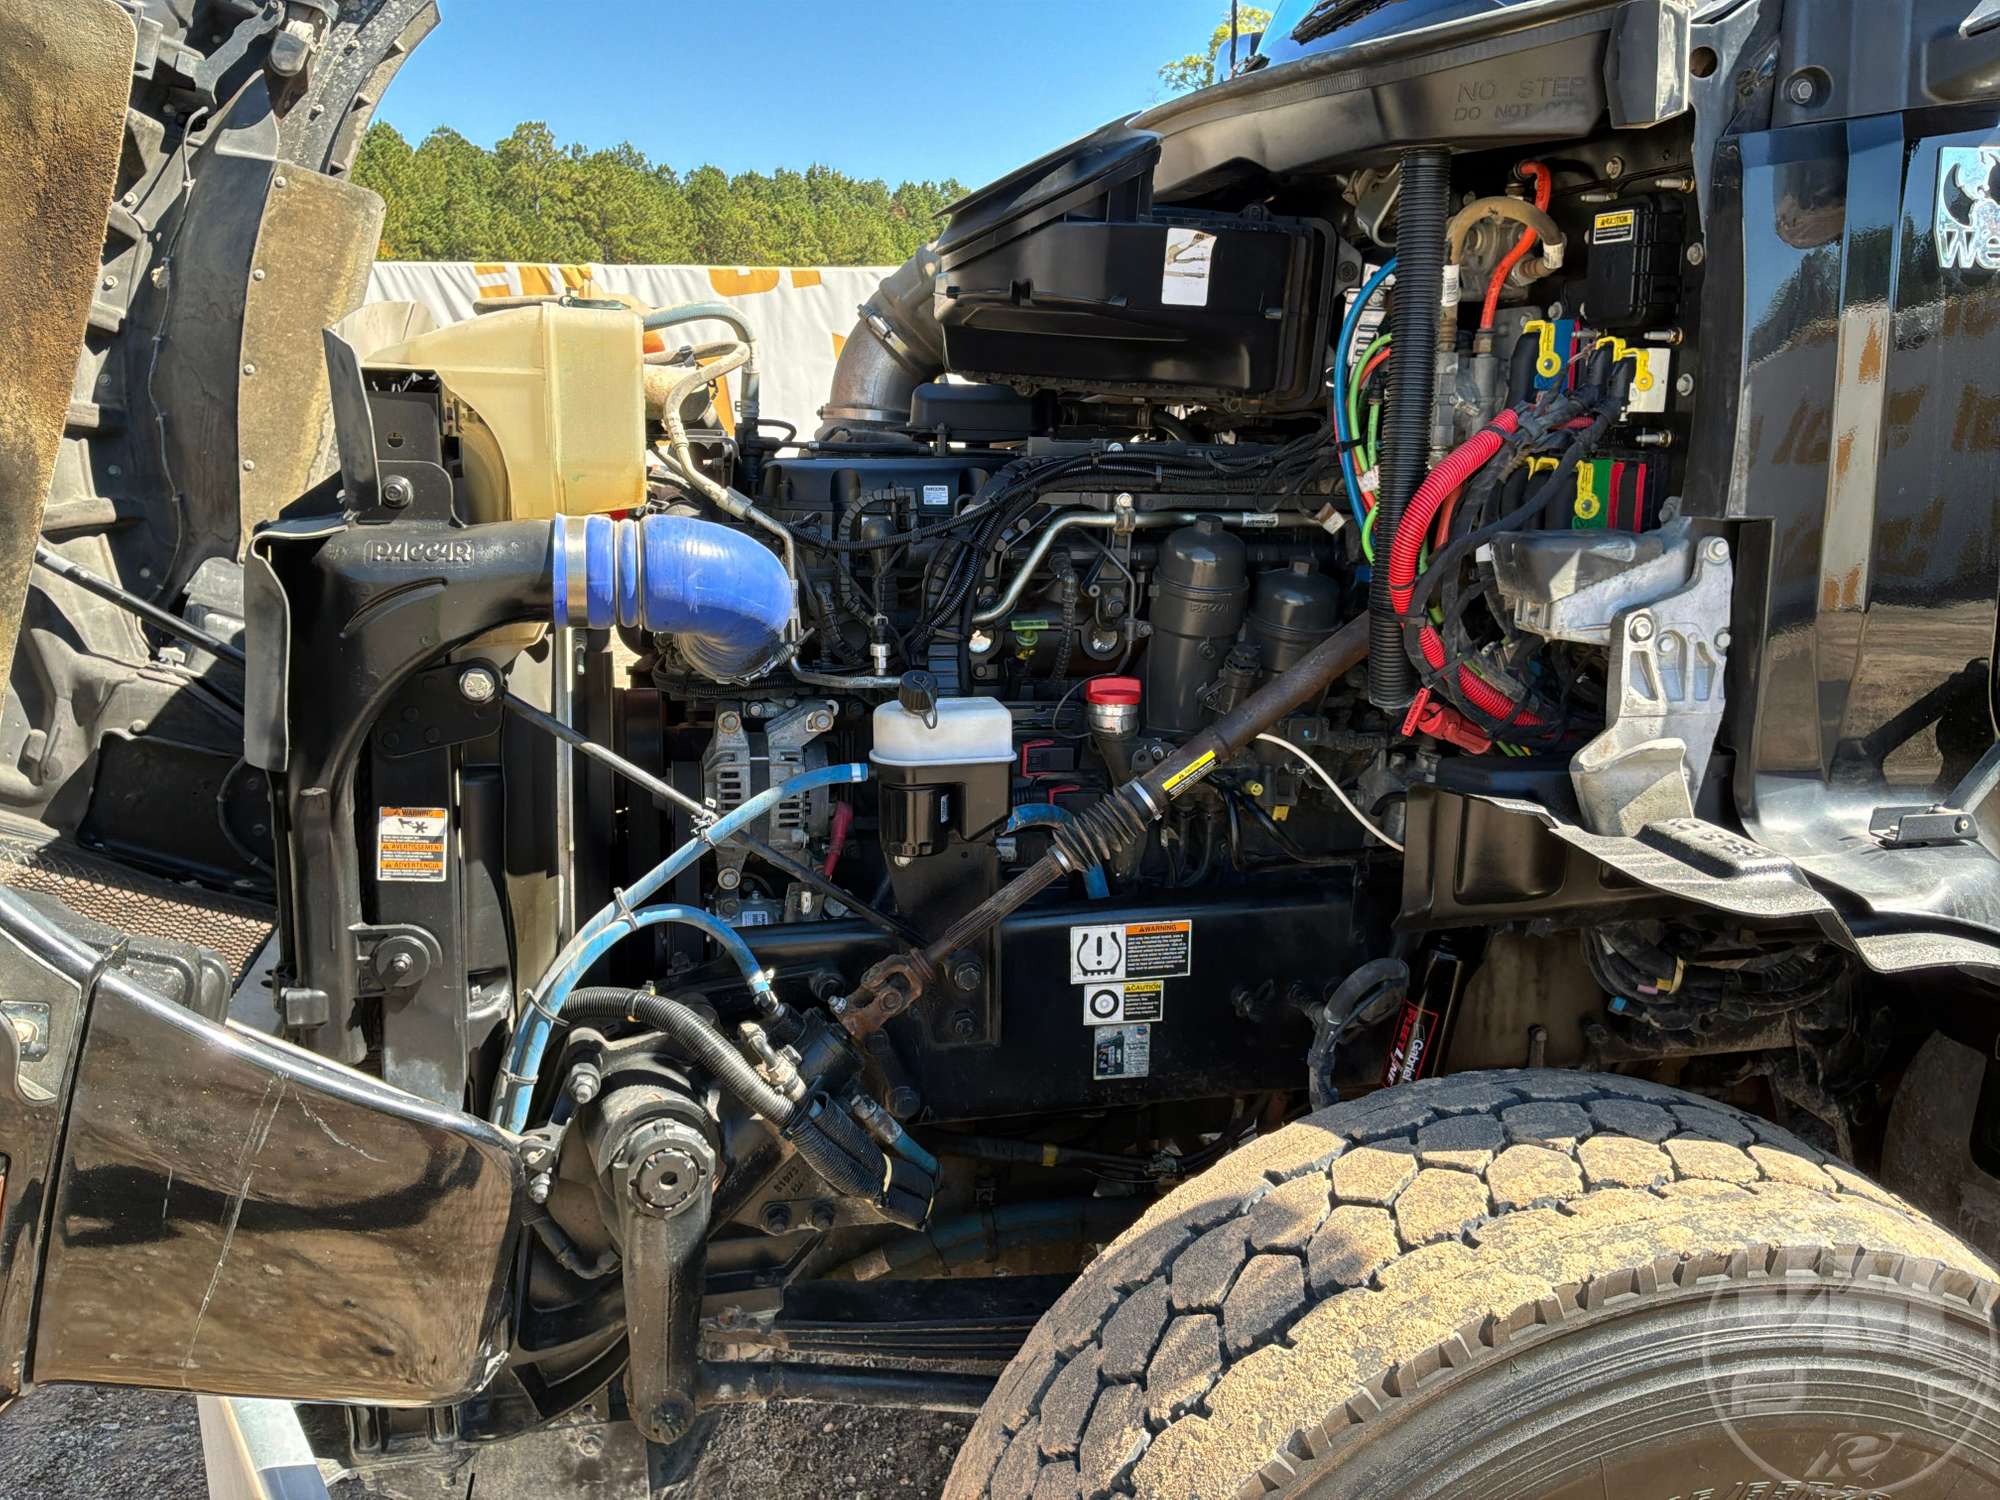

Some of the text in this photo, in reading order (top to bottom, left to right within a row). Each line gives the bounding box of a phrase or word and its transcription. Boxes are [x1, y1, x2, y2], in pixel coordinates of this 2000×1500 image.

[1457, 76, 1586, 102] NO STEP
[1454, 106, 1481, 121] DO
[1494, 103, 1533, 119] NOT
[371, 542, 472, 562] PACCAR
[402, 809, 433, 817] WARNING
[1144, 924, 1177, 932] WARNING
[1131, 982, 1161, 991] CAUTION
[1402, 1040, 1424, 1081] Gabriel
